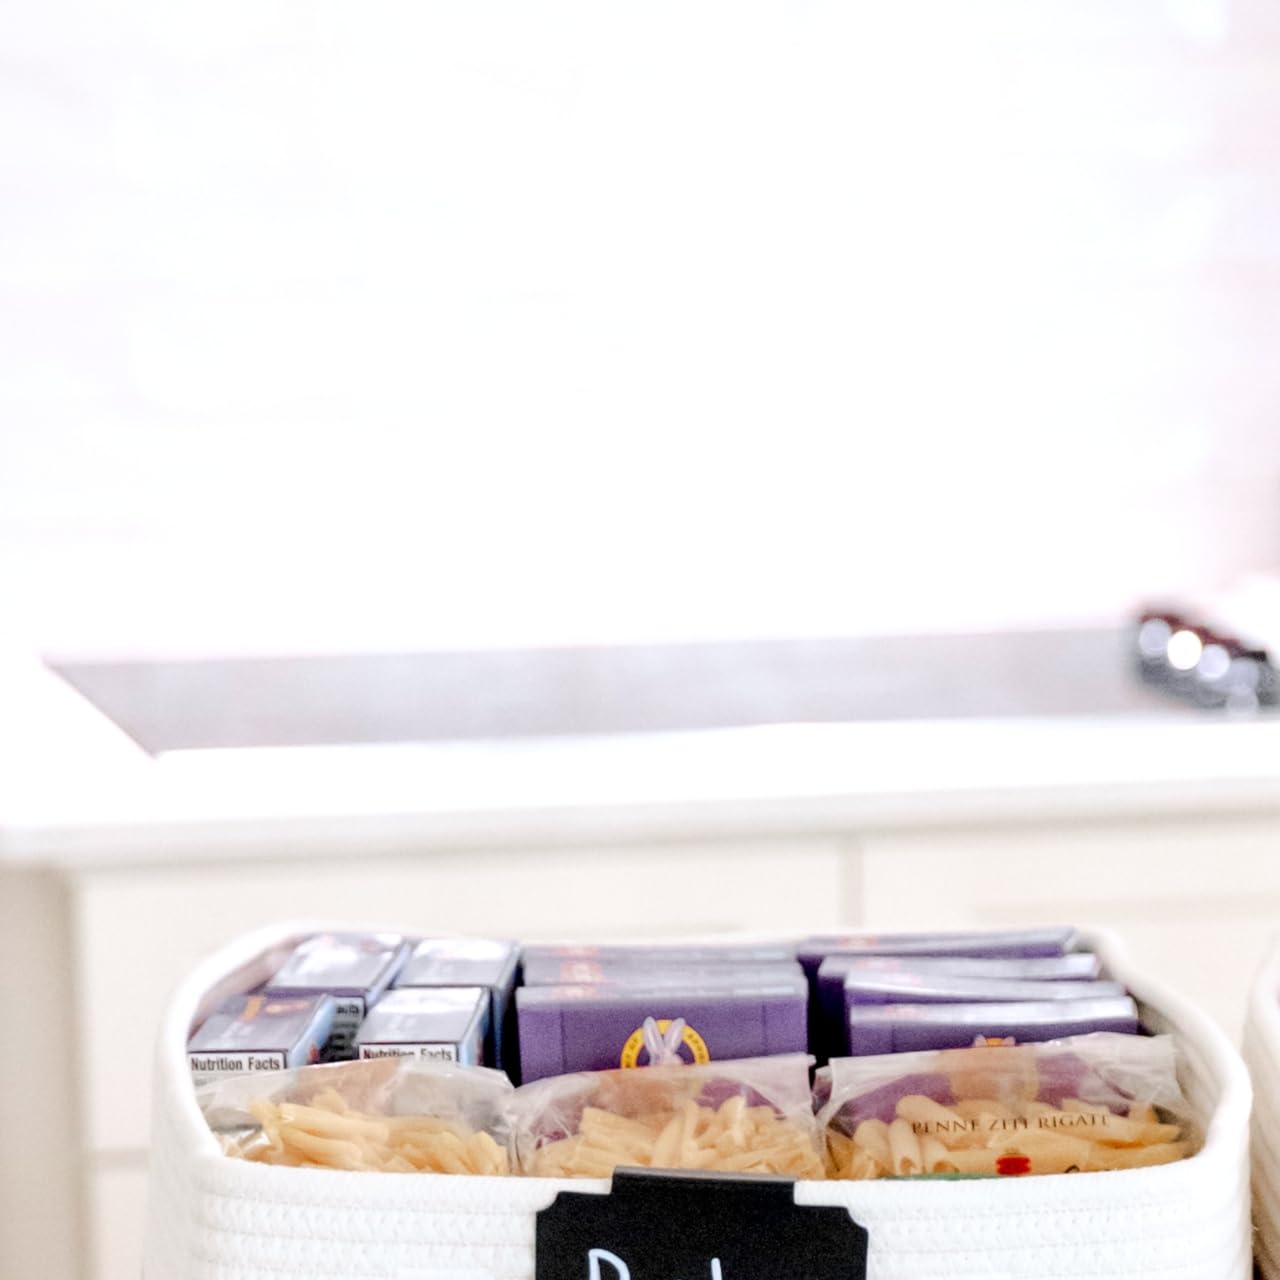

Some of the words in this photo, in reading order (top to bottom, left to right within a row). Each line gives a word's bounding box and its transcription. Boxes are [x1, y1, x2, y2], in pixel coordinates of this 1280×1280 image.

[190, 1055, 243, 1072] Nutrition
[247, 1055, 281, 1072] Facts
[911, 1118, 978, 1136] PENNE
[988, 1117, 1030, 1131] ZITI
[1037, 1112, 1110, 1129] RIGATE
